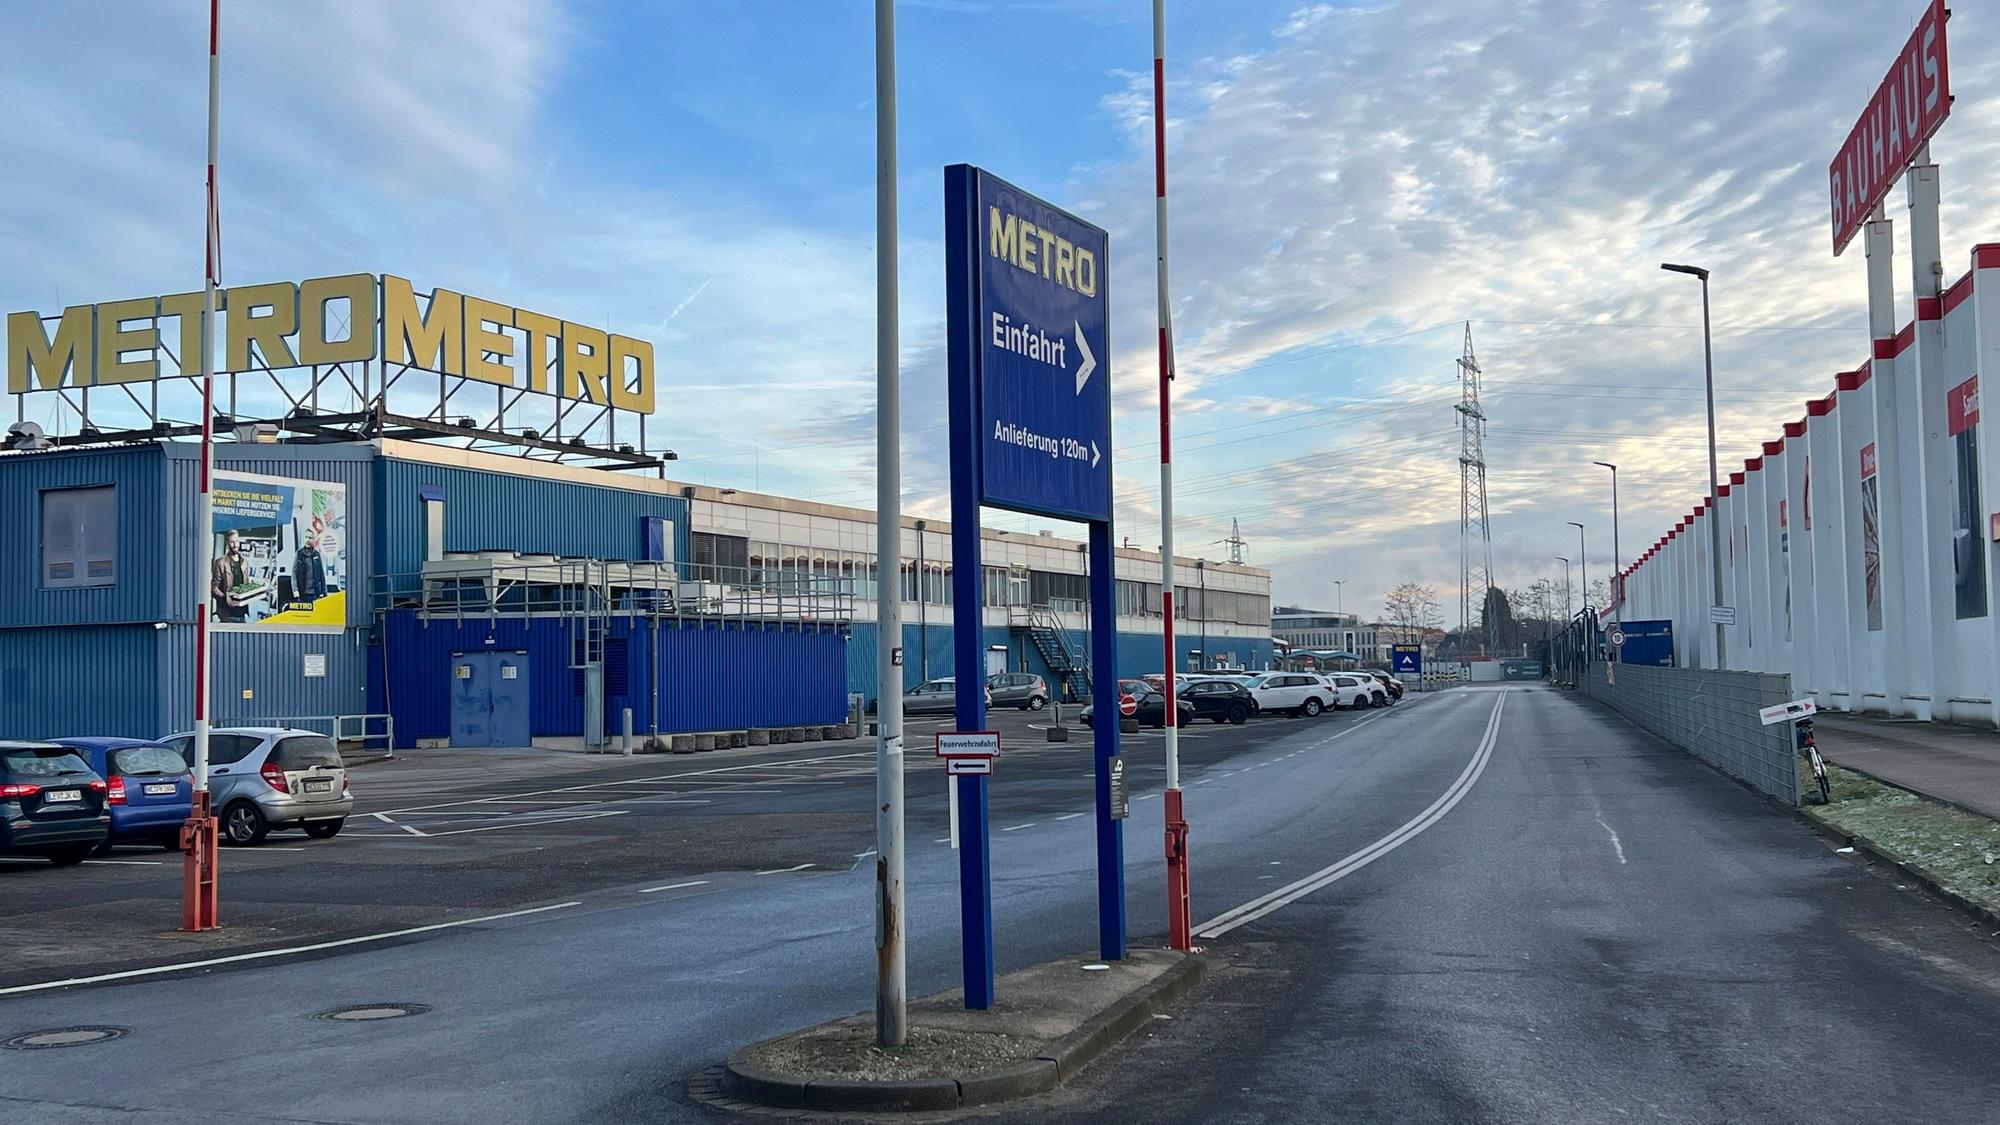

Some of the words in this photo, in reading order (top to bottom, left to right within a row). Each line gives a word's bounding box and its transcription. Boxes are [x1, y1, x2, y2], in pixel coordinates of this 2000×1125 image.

[1832, 21, 1939, 239] BAUHAUS
[990, 206, 1096, 297] METRO
[7, 273, 377, 394] METRO
[380, 274, 655, 415] METRO
[993, 312, 1066, 369] Einfahrt
[995, 420, 1058, 458] Anlieferung
[1061, 437, 1088, 461] 120m
[212, 506, 235, 515] NSEREN
[236, 507, 276, 519] LIEFERSERVICE!
[218, 498, 235, 507] MARKT
[236, 500, 250, 508] ODER
[251, 501, 271, 510] NUTZEN
[272, 503, 280, 511] SIE
[260, 494, 284, 503] VIELFALT
[289, 602, 313, 610] METRO
[940, 739, 996, 748] Feuerwehrzufahrt
